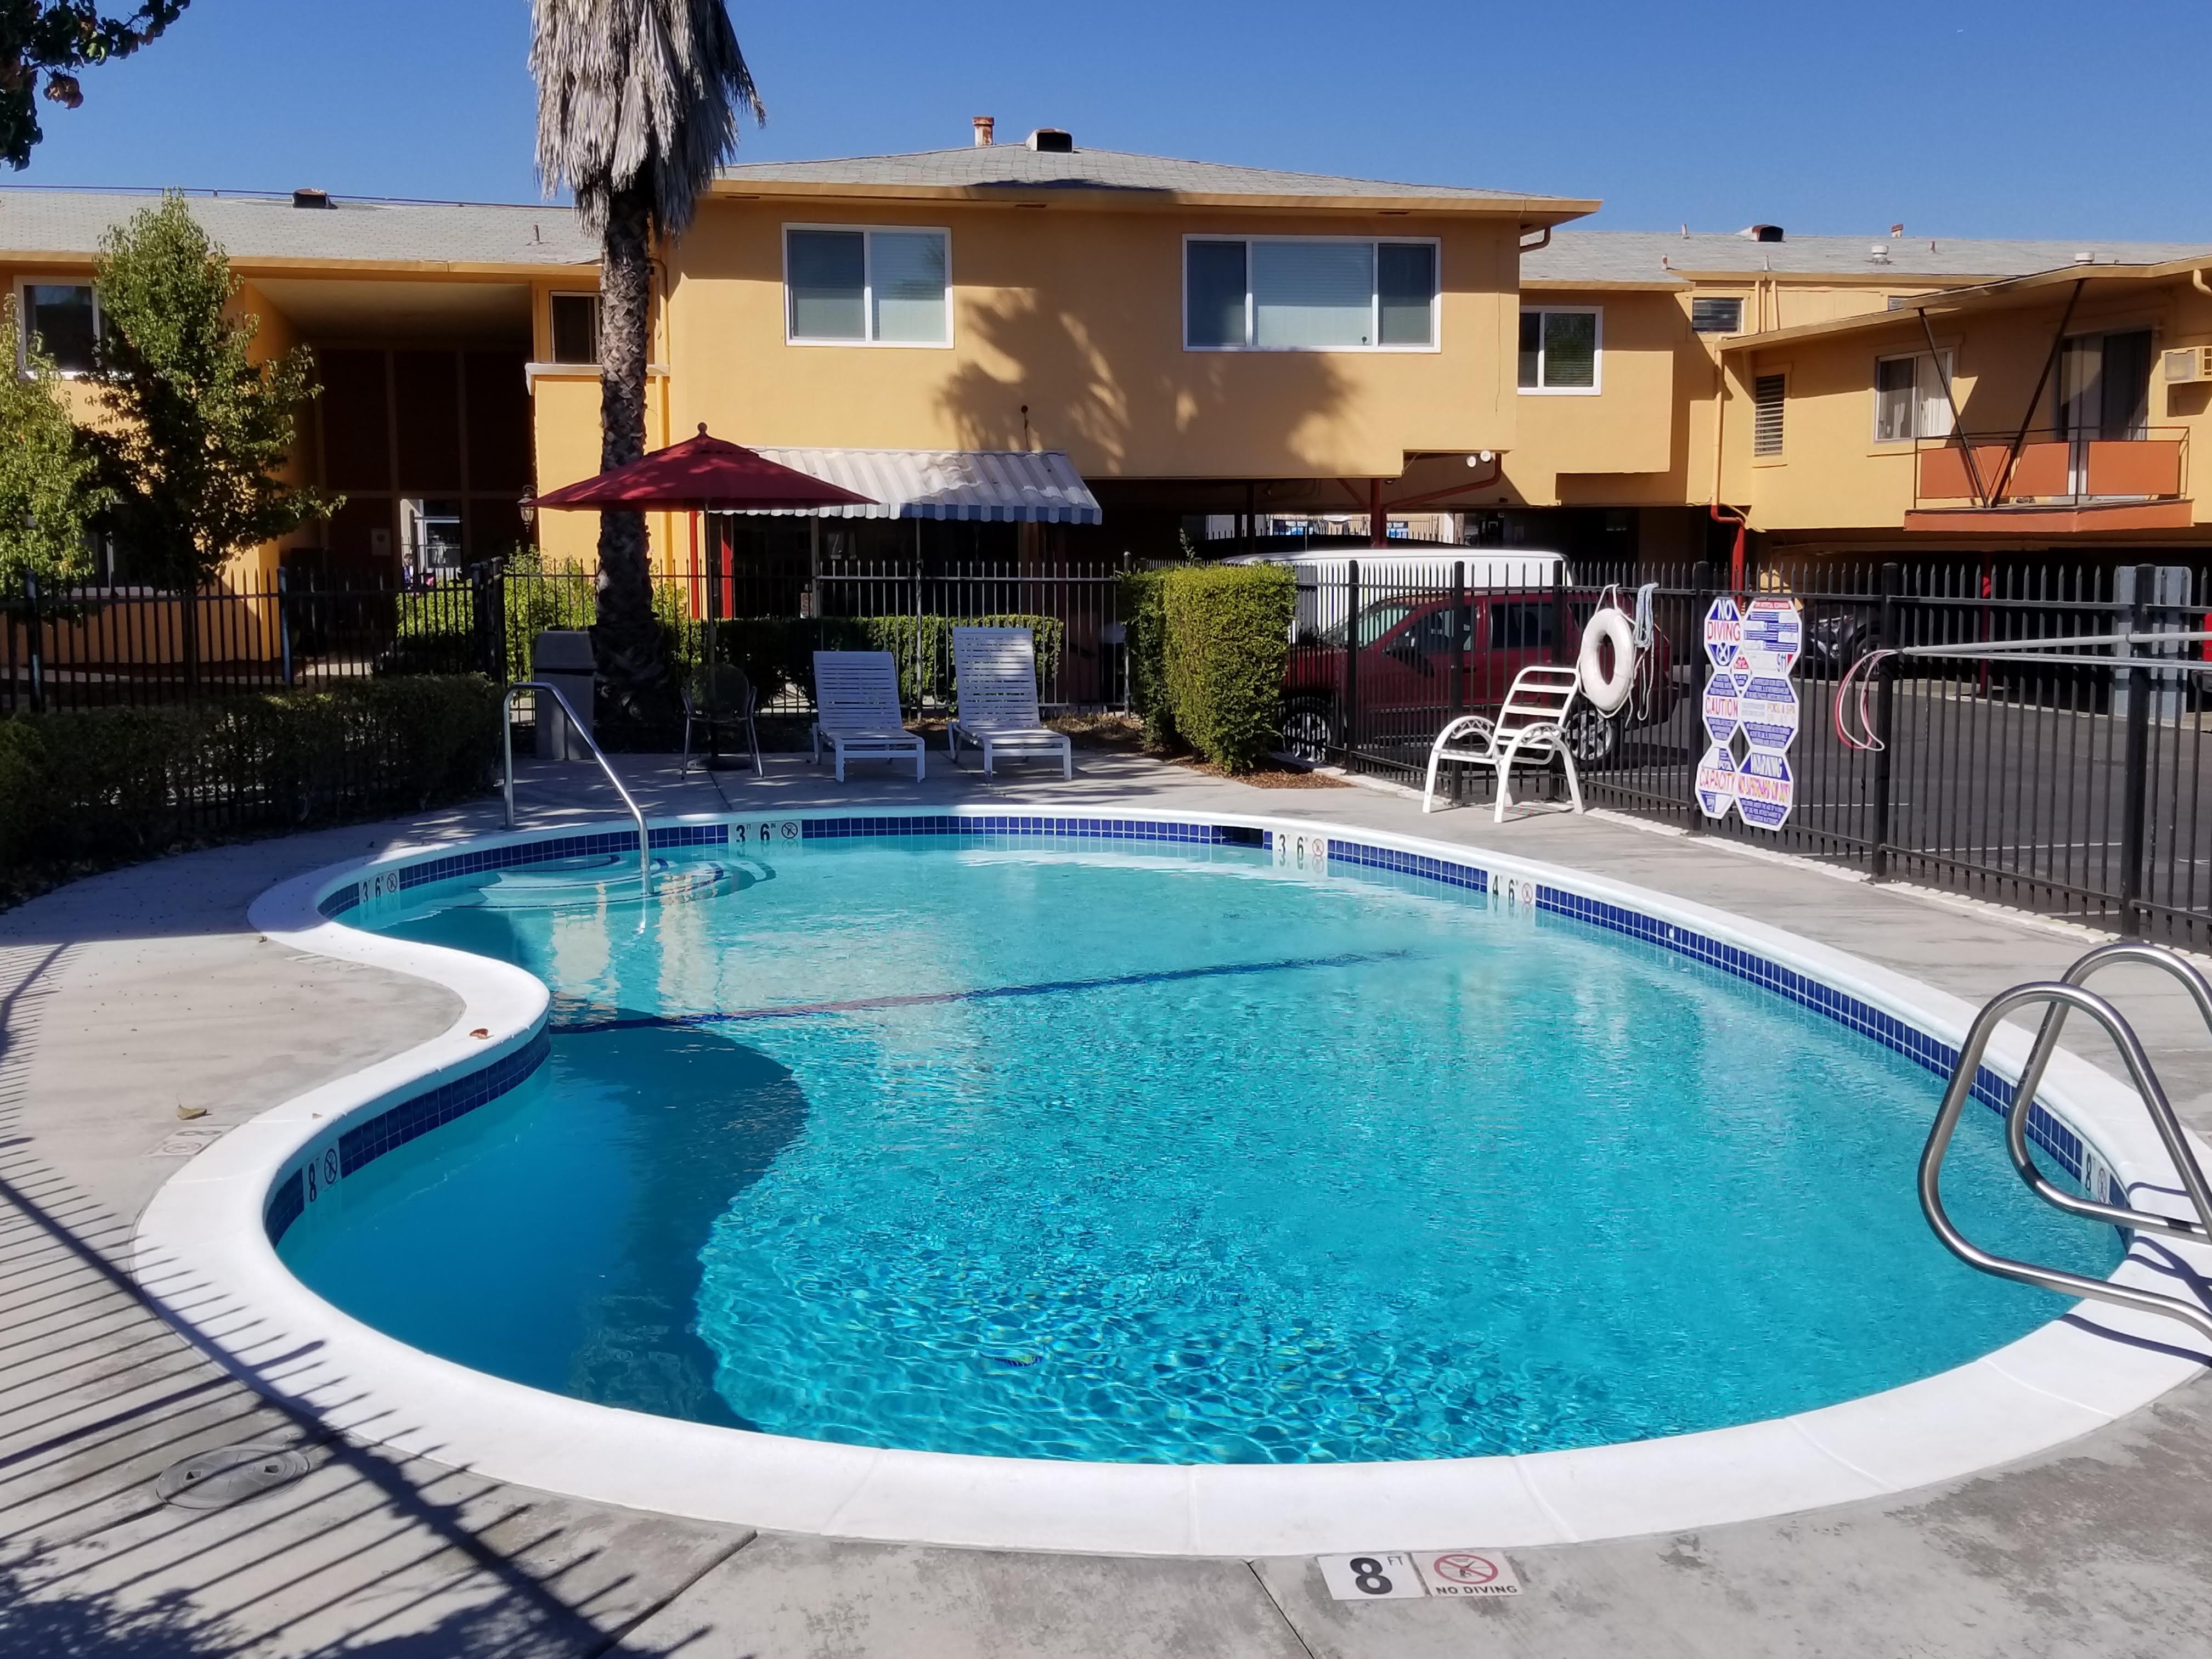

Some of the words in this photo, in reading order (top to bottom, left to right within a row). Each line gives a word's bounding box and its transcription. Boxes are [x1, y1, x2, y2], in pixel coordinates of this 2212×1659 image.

[1718, 600, 1733, 620] NO
[1707, 622, 1741, 641] DIVING
[1706, 697, 1738, 717] CAUTION
[736, 825, 746, 843] 3
[760, 823, 770, 841] 6
[1278, 834, 1286, 853] 3
[1297, 836, 1304, 856] 6
[363, 881, 369, 903] 3
[375, 877, 381, 898] 6
[1492, 874, 1499, 896] 4
[1508, 879, 1514, 900] 6
[308, 1163, 317, 1203] 8
[2085, 1153, 2092, 1192] 8
[1350, 1557, 1393, 1595] 8
[1387, 1556, 1403, 1566] FT
[1435, 1587, 1458, 1595] NO
[1463, 1585, 1517, 1594] DIVING
